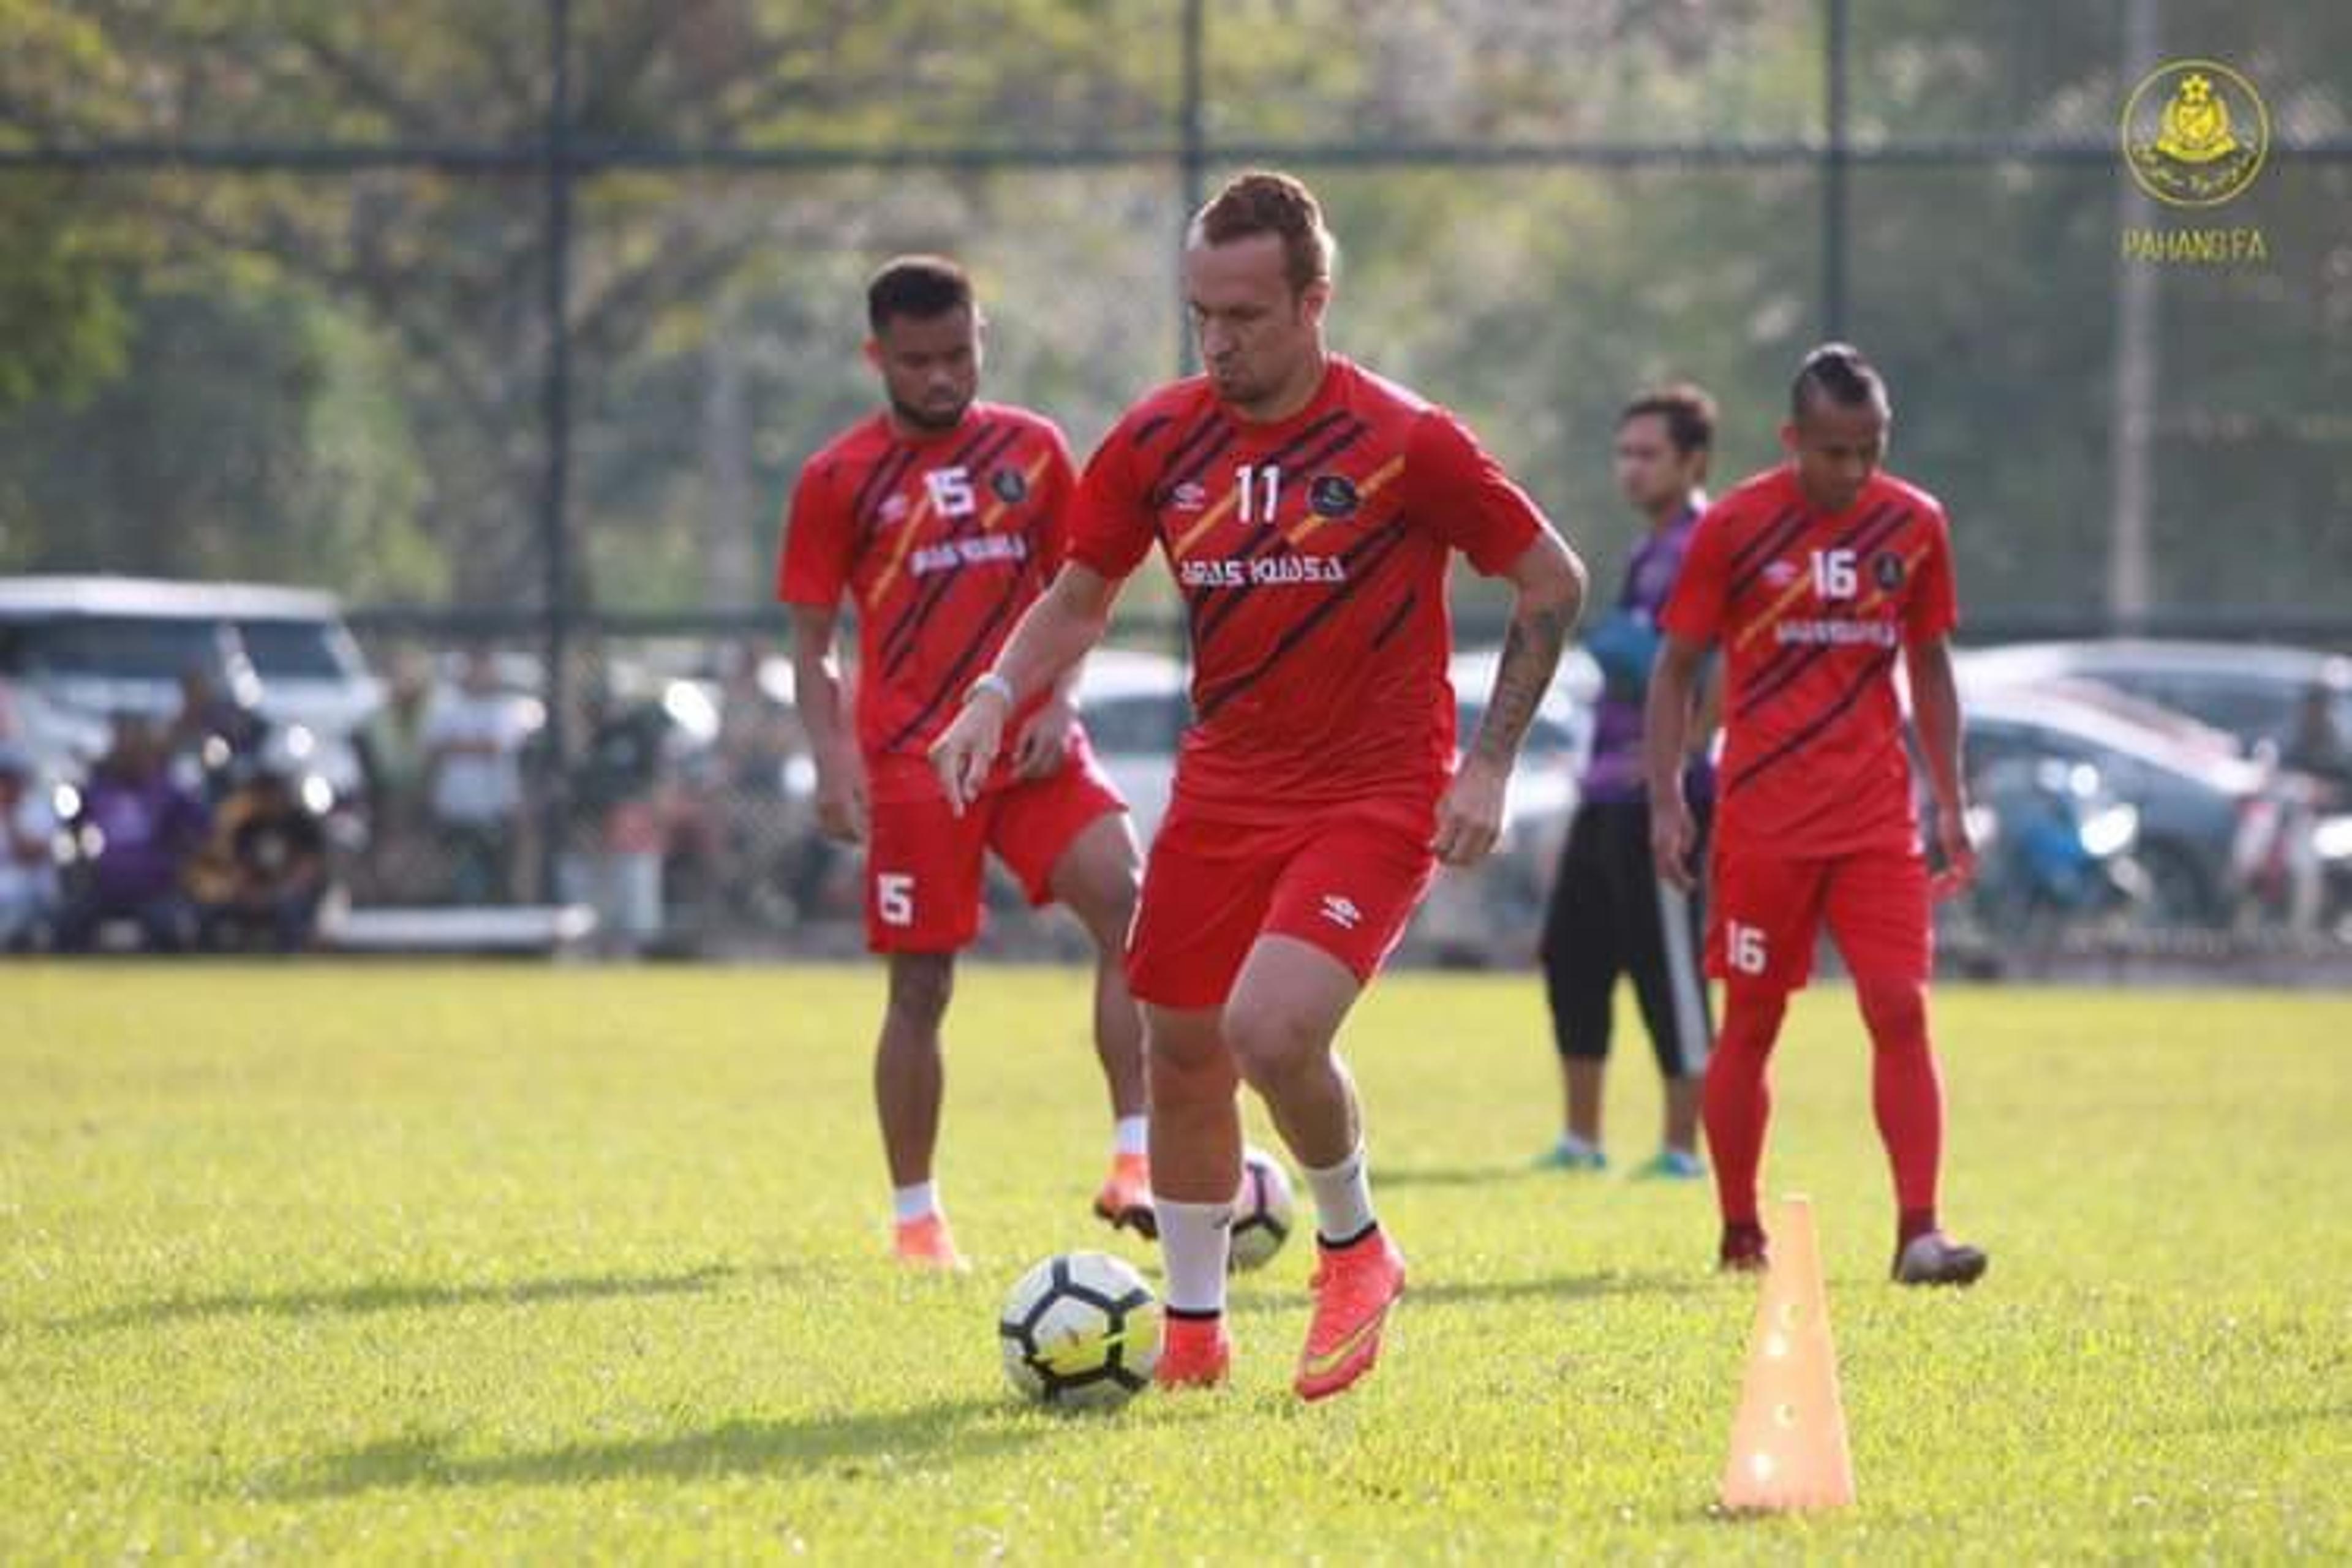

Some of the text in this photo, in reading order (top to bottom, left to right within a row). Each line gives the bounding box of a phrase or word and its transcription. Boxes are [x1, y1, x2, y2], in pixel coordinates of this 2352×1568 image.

[924, 466, 976, 518] 15
[1235, 464, 1280, 523] 11
[1810, 548, 1858, 600] 16
[1725, 919, 1766, 974] 16
